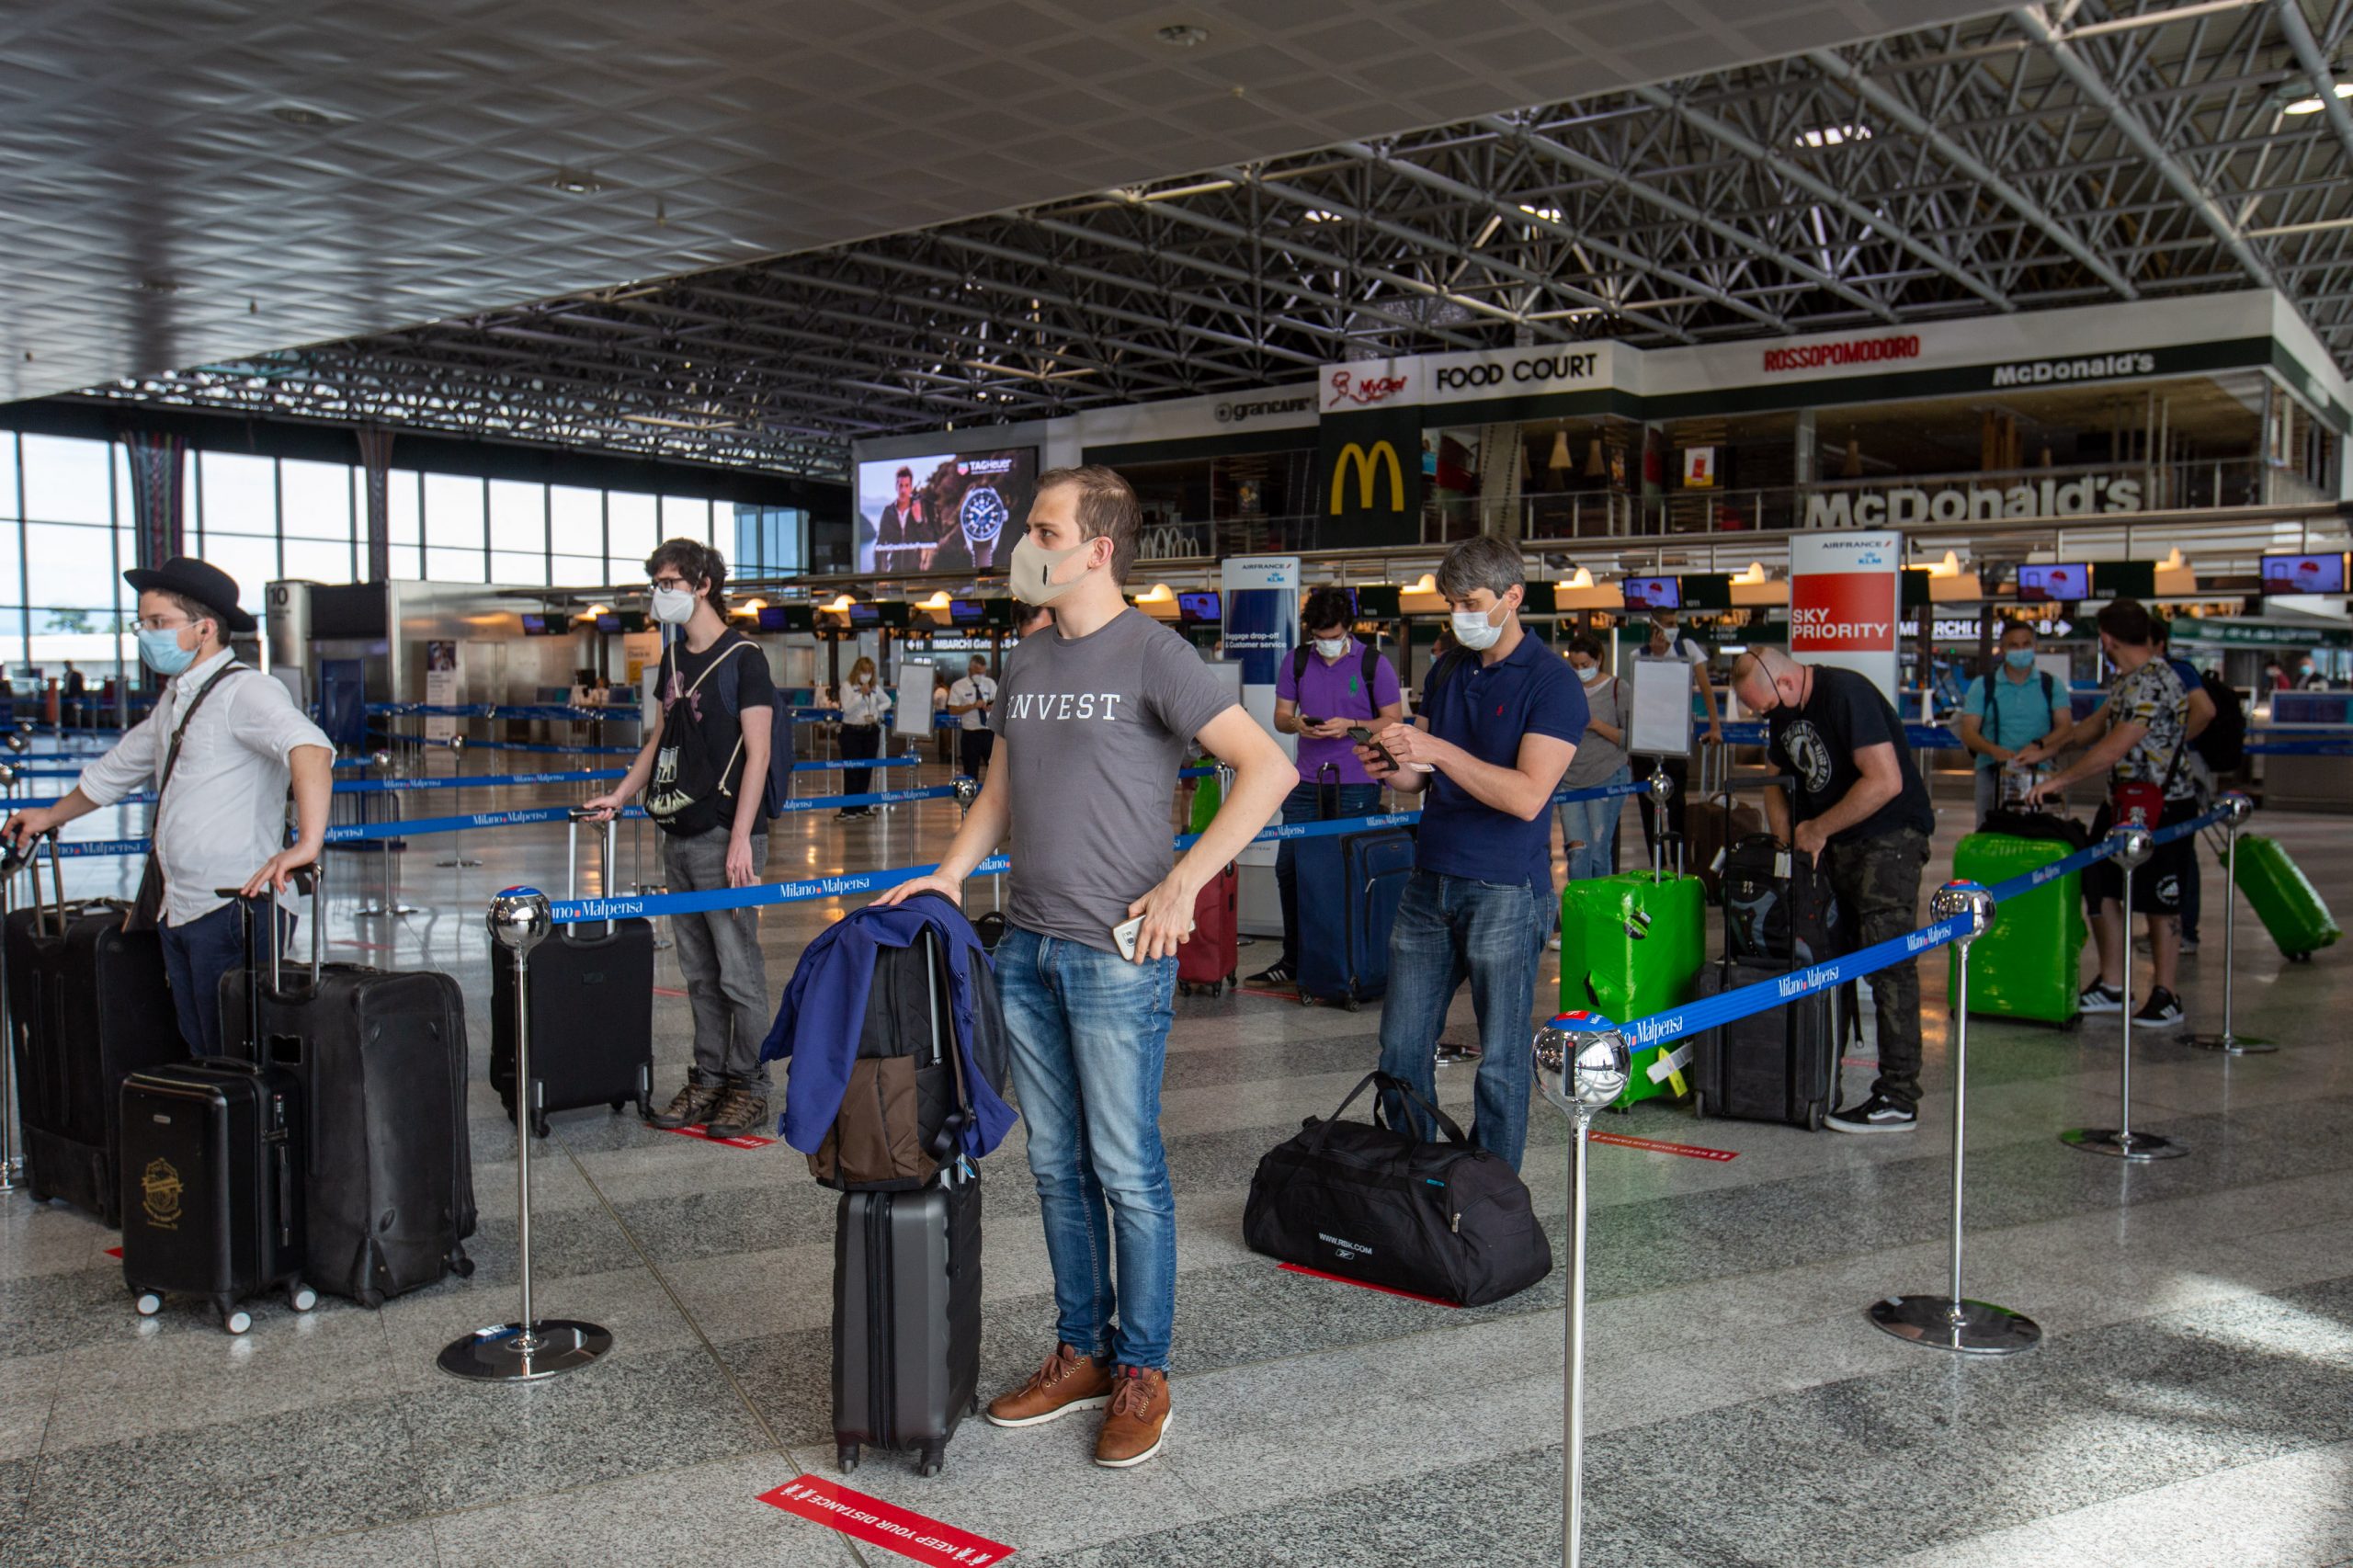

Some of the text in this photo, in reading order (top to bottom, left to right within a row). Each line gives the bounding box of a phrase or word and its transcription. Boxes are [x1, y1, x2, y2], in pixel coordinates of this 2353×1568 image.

[1763, 335, 1920, 372] ROSSOPOMODORO
[1437, 353, 1597, 391] FOOD COURT
[1993, 353, 2155, 387] McDonald's
[1804, 477, 2142, 528] McDonald's
[270, 587, 289, 606] 10
[1792, 608, 1830, 624] SKY
[1250, 632, 1279, 641] drop-off
[1792, 622, 1888, 640] PRIORITY
[536, 774, 565, 783] Malpensa
[472, 811, 548, 825] Milano Malpensa
[1366, 815, 1409, 827] Milano Malpensa
[324, 827, 364, 841] alpensa
[1256, 825, 1305, 838] ilano Malpensa
[80, 842, 141, 856] Malpensa
[780, 877, 870, 898] Milano Malpensa
[582, 900, 643, 919] Malpensa
[1906, 924, 1952, 951] Milano Malpensa
[1779, 966, 1839, 998] Milano Malpensa
[1636, 1015, 1683, 1045] Malpensa
[1318, 1232, 1372, 1256] WWW.RBK.COM
[808, 1494, 960, 1555] KEEP YOUR DISTANCE
